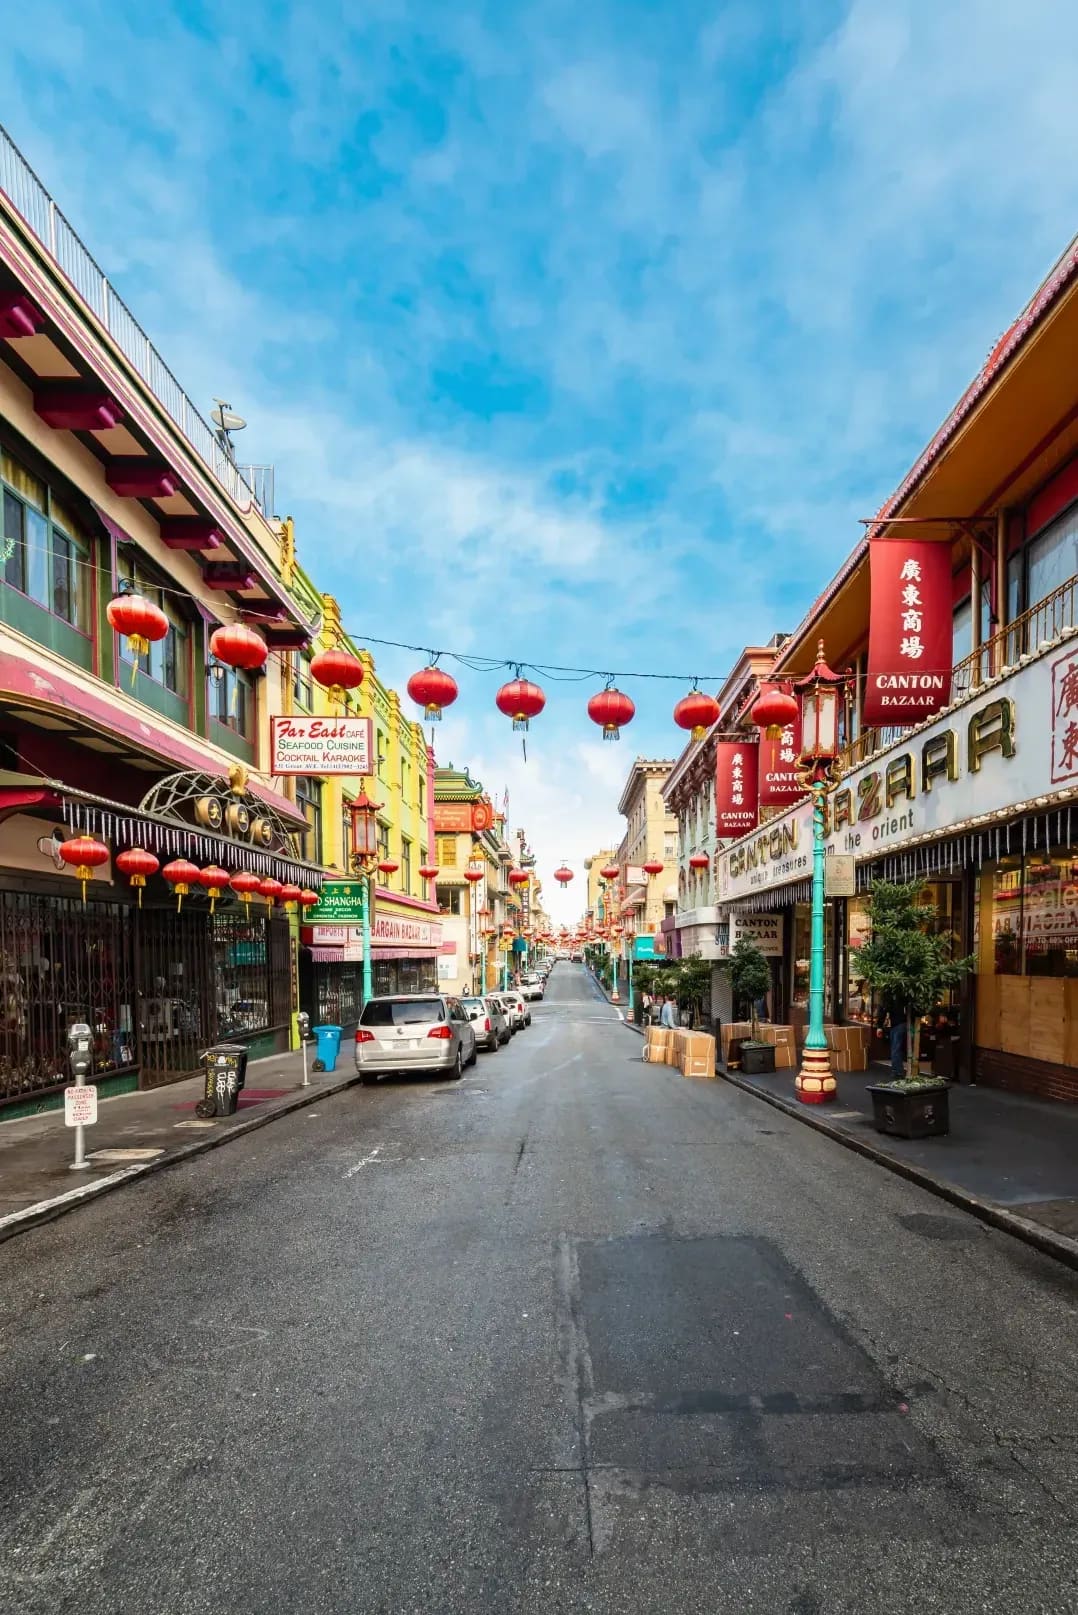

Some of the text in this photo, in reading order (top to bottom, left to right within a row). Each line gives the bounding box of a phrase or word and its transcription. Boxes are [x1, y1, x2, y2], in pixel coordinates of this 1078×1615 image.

[900, 559, 924, 659] 廣東商場
[876, 675, 943, 689] CANTON
[881, 696, 934, 706] BAZAAR
[276, 720, 305, 738] Far
[308, 721, 346, 738] East
[730, 819, 798, 878] CANTON
[773, 855, 807, 877] treasures
[845, 833, 861, 852] the
[872, 808, 914, 841] orient
[325, 896, 362, 906] SHANGHA
[371, 920, 400, 938] BARGAIN
[735, 919, 777, 927] CANTON
[735, 930, 777, 938] BZAAR
